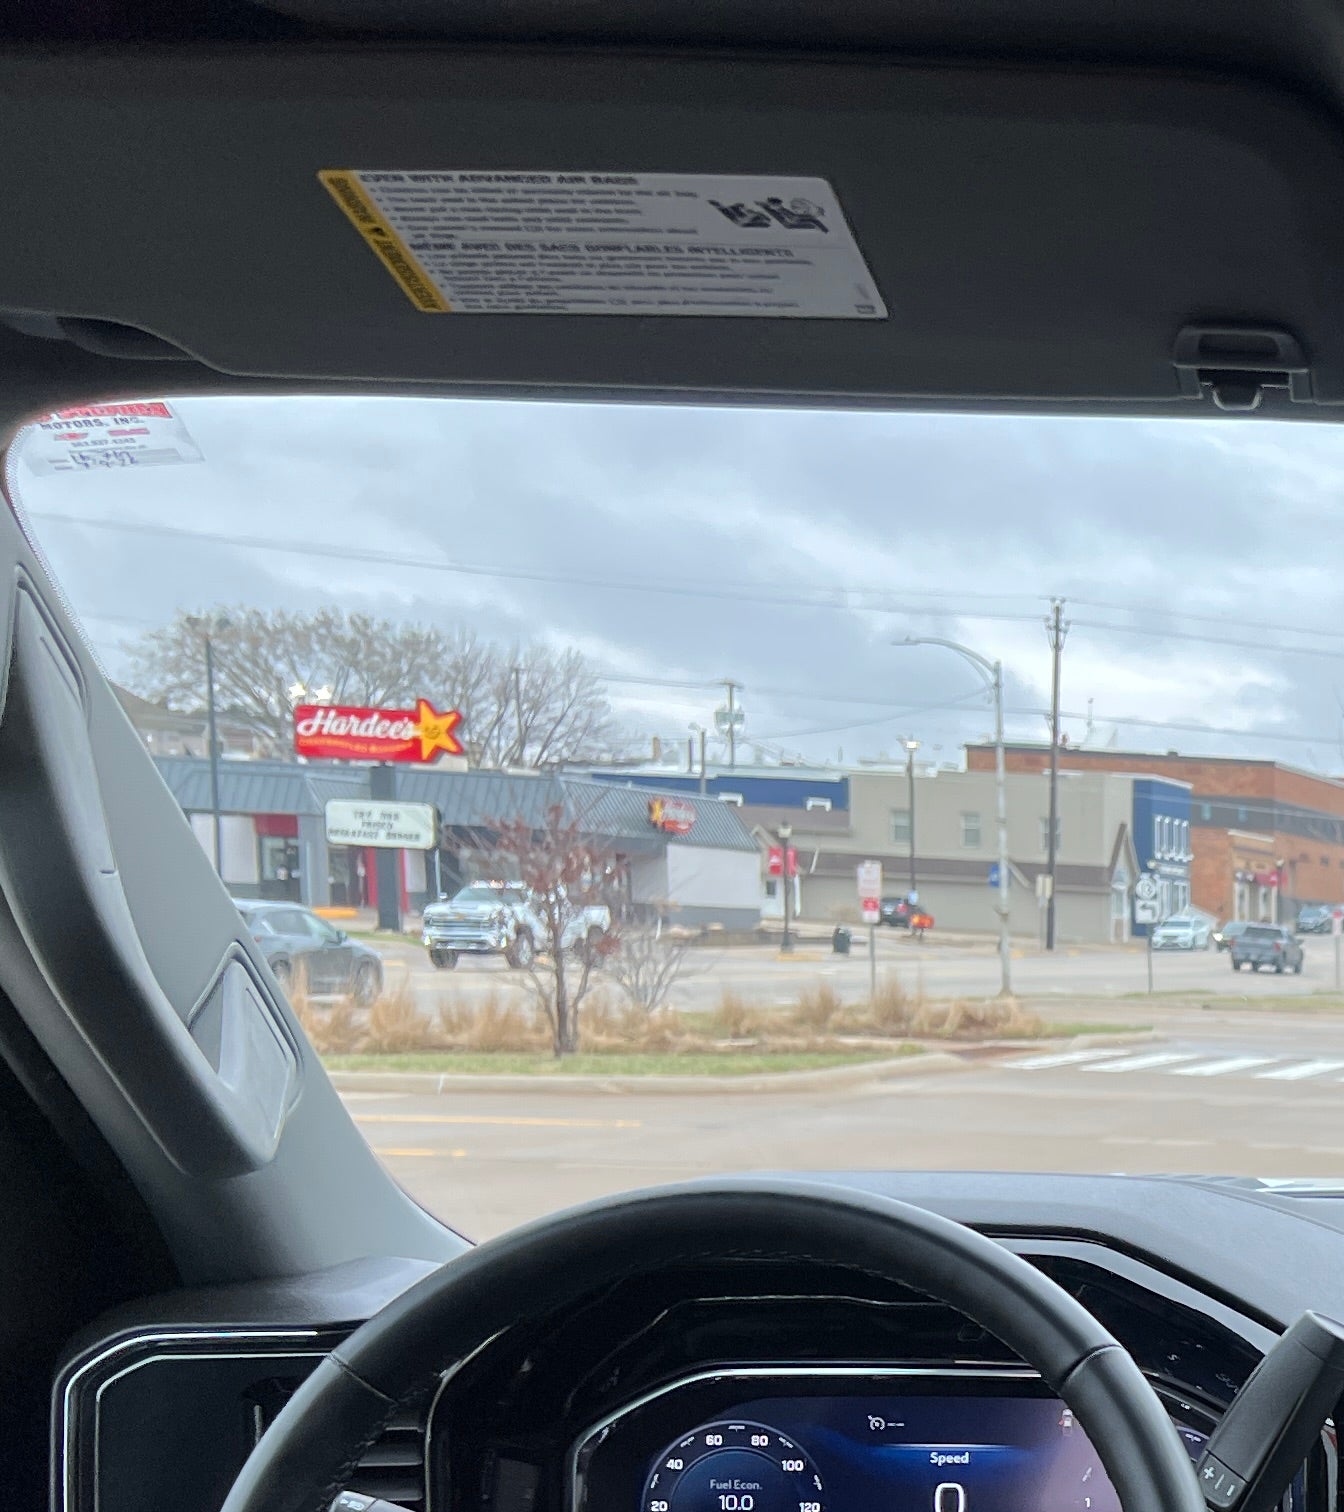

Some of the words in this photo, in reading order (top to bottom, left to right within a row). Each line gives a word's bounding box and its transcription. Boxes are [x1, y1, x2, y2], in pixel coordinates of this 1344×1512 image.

[297, 709, 415, 741] Hardee's
[705, 1434, 723, 1446] 60
[751, 1435, 769, 1446] 80
[666, 1458, 683, 1470] 40
[929, 1451, 970, 1466] Speed
[781, 1460, 804, 1472] 100
[710, 1479, 731, 1490] Fuel
[734, 1479, 763, 1490] Econ.
[650, 1500, 668, 1512] 20
[718, 1495, 754, 1511] 10.0
[1085, 1497, 1091, 1508] 1
